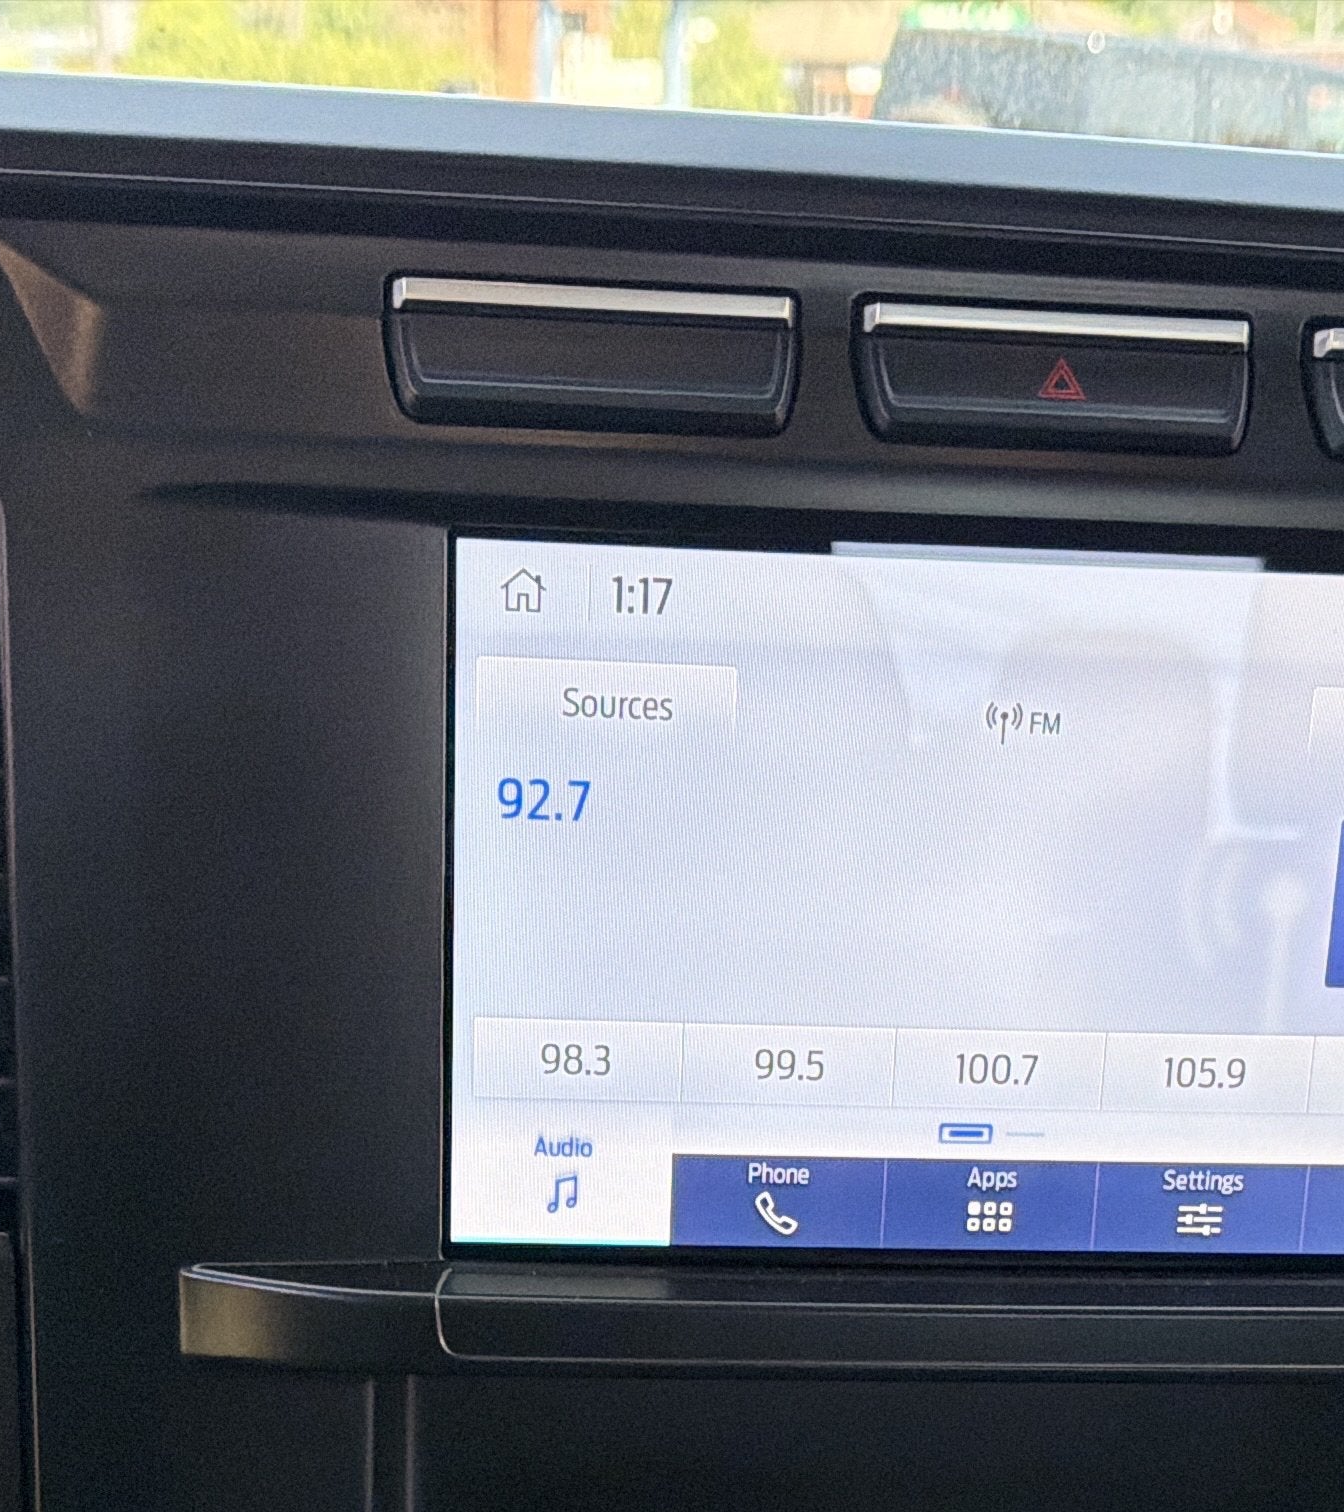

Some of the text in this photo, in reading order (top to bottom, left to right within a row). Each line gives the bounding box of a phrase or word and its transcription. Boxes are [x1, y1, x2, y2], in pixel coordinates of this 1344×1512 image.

[612, 576, 673, 614] 1:17
[562, 687, 673, 721] Sources
[1029, 711, 1061, 735] FM
[498, 777, 591, 822] 92.7
[541, 1043, 611, 1076] 98.3
[755, 1048, 824, 1081] 99.5
[956, 1053, 1039, 1086] 100.7
[1164, 1057, 1246, 1089] 105.9
[534, 1135, 593, 1158] Audio
[748, 1162, 810, 1186] Phone
[967, 1166, 1018, 1193] Apps
[1162, 1169, 1244, 1196] Settings
